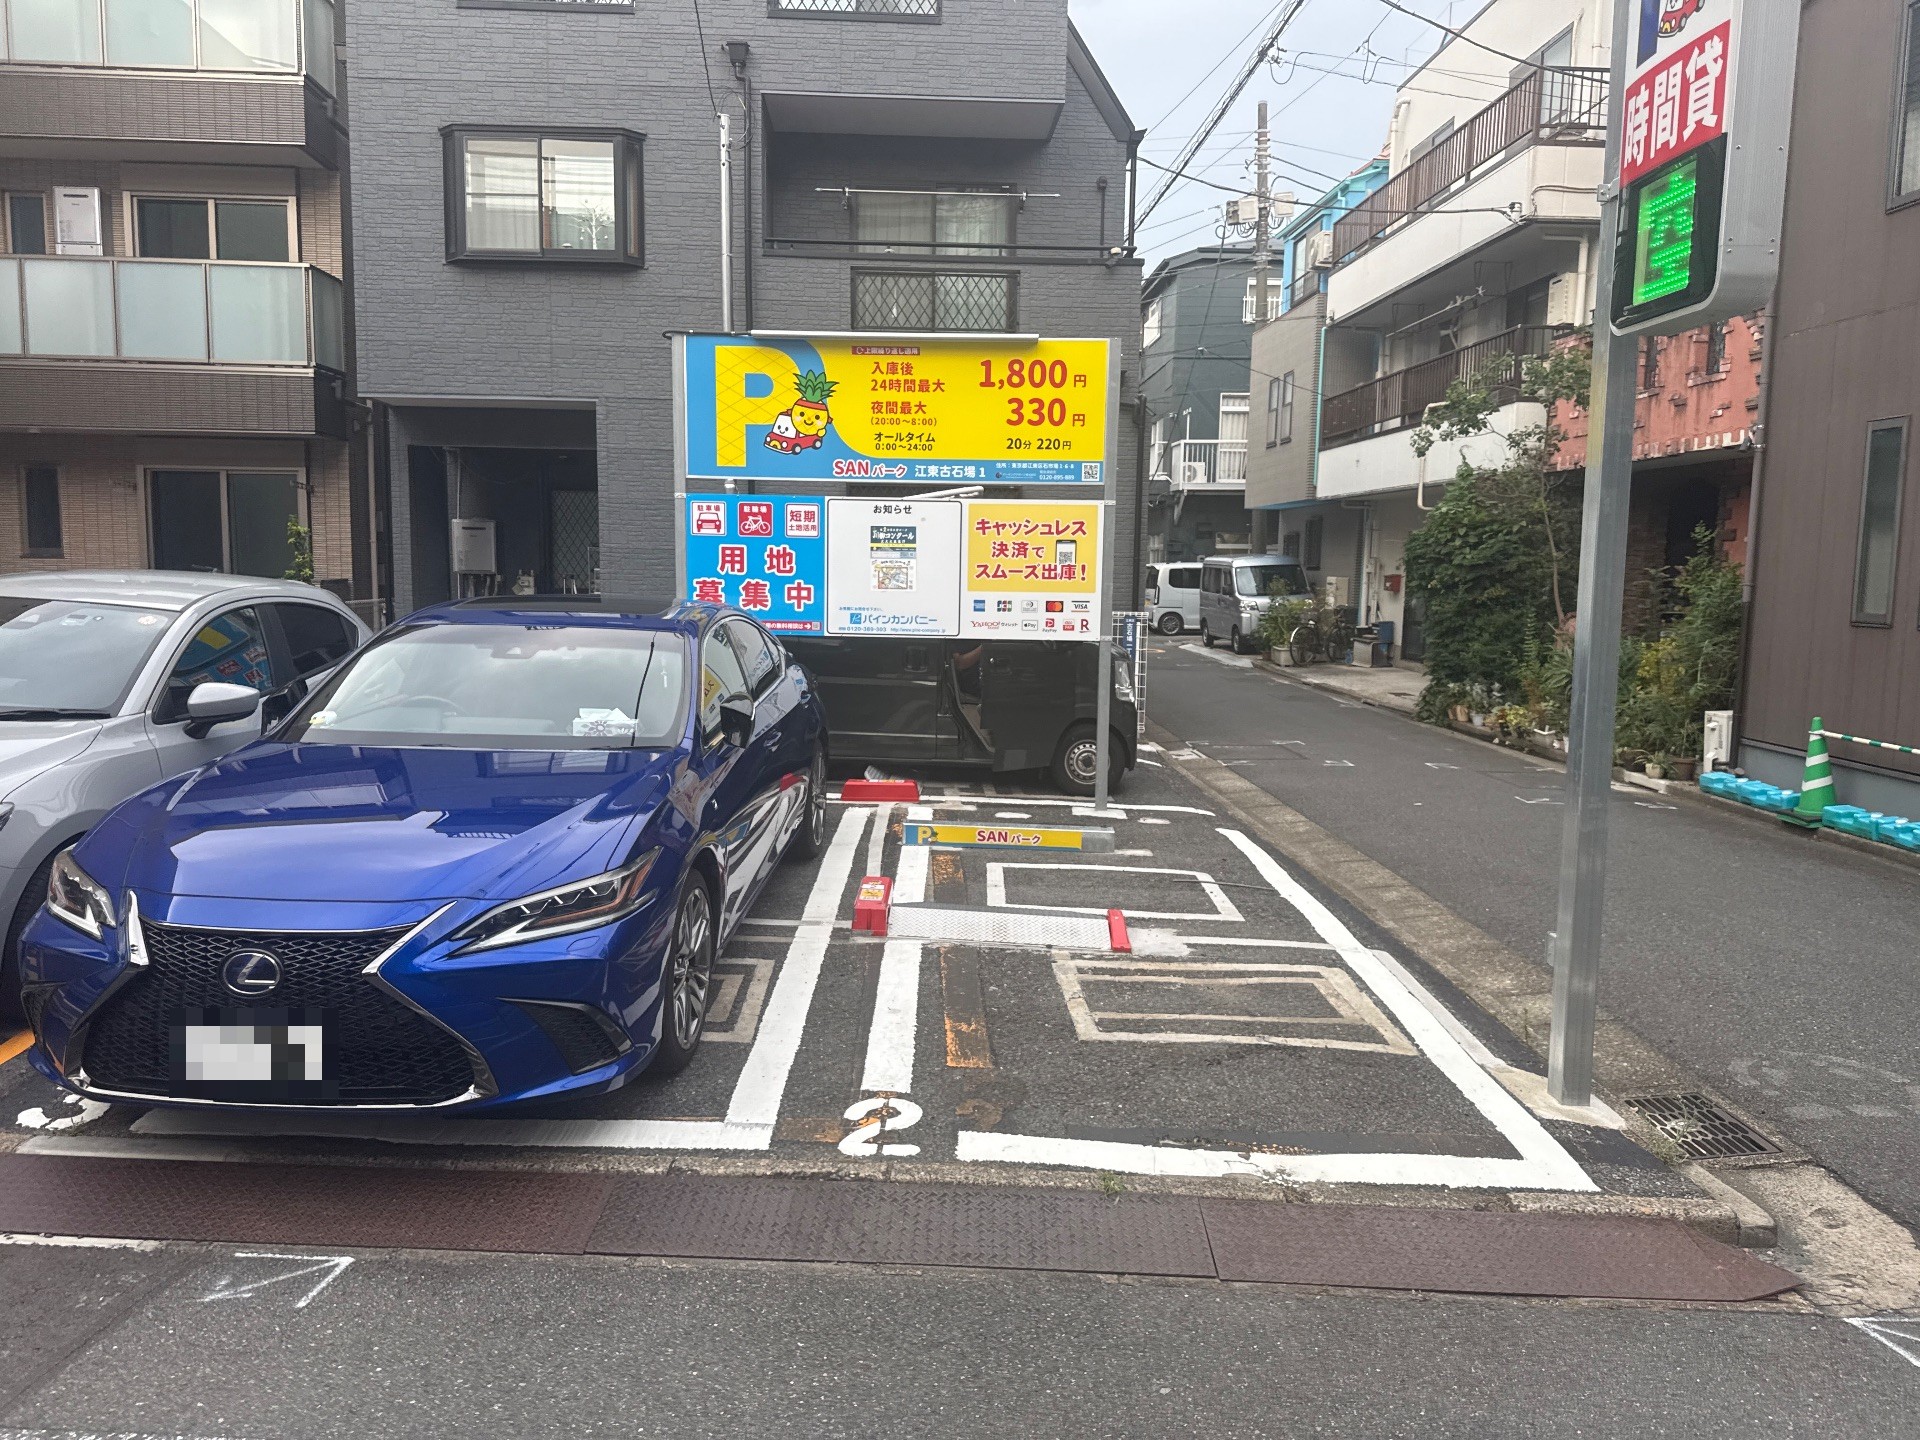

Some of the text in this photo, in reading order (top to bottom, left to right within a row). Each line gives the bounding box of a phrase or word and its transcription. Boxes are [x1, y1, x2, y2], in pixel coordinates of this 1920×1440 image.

[1624, 35, 1723, 169] 時間貸
[871, 361, 914, 375] 入庫後
[871, 378, 945, 393] 24時間最大
[715, 345, 800, 467] P
[871, 401, 927, 414] 夜間最大
[874, 432, 936, 442] オールタイム
[697, 504, 721, 512] 駐車場
[873, 504, 912, 514] お知らせ
[789, 510, 816, 523] 短期
[788, 524, 817, 532] 土地活用
[976, 519, 1087, 536] キャッシュレス
[991, 541, 1045, 559] 決済で
[863, 614, 938, 625] パインカンパニー
[837, 1098, 923, 1156] 2
